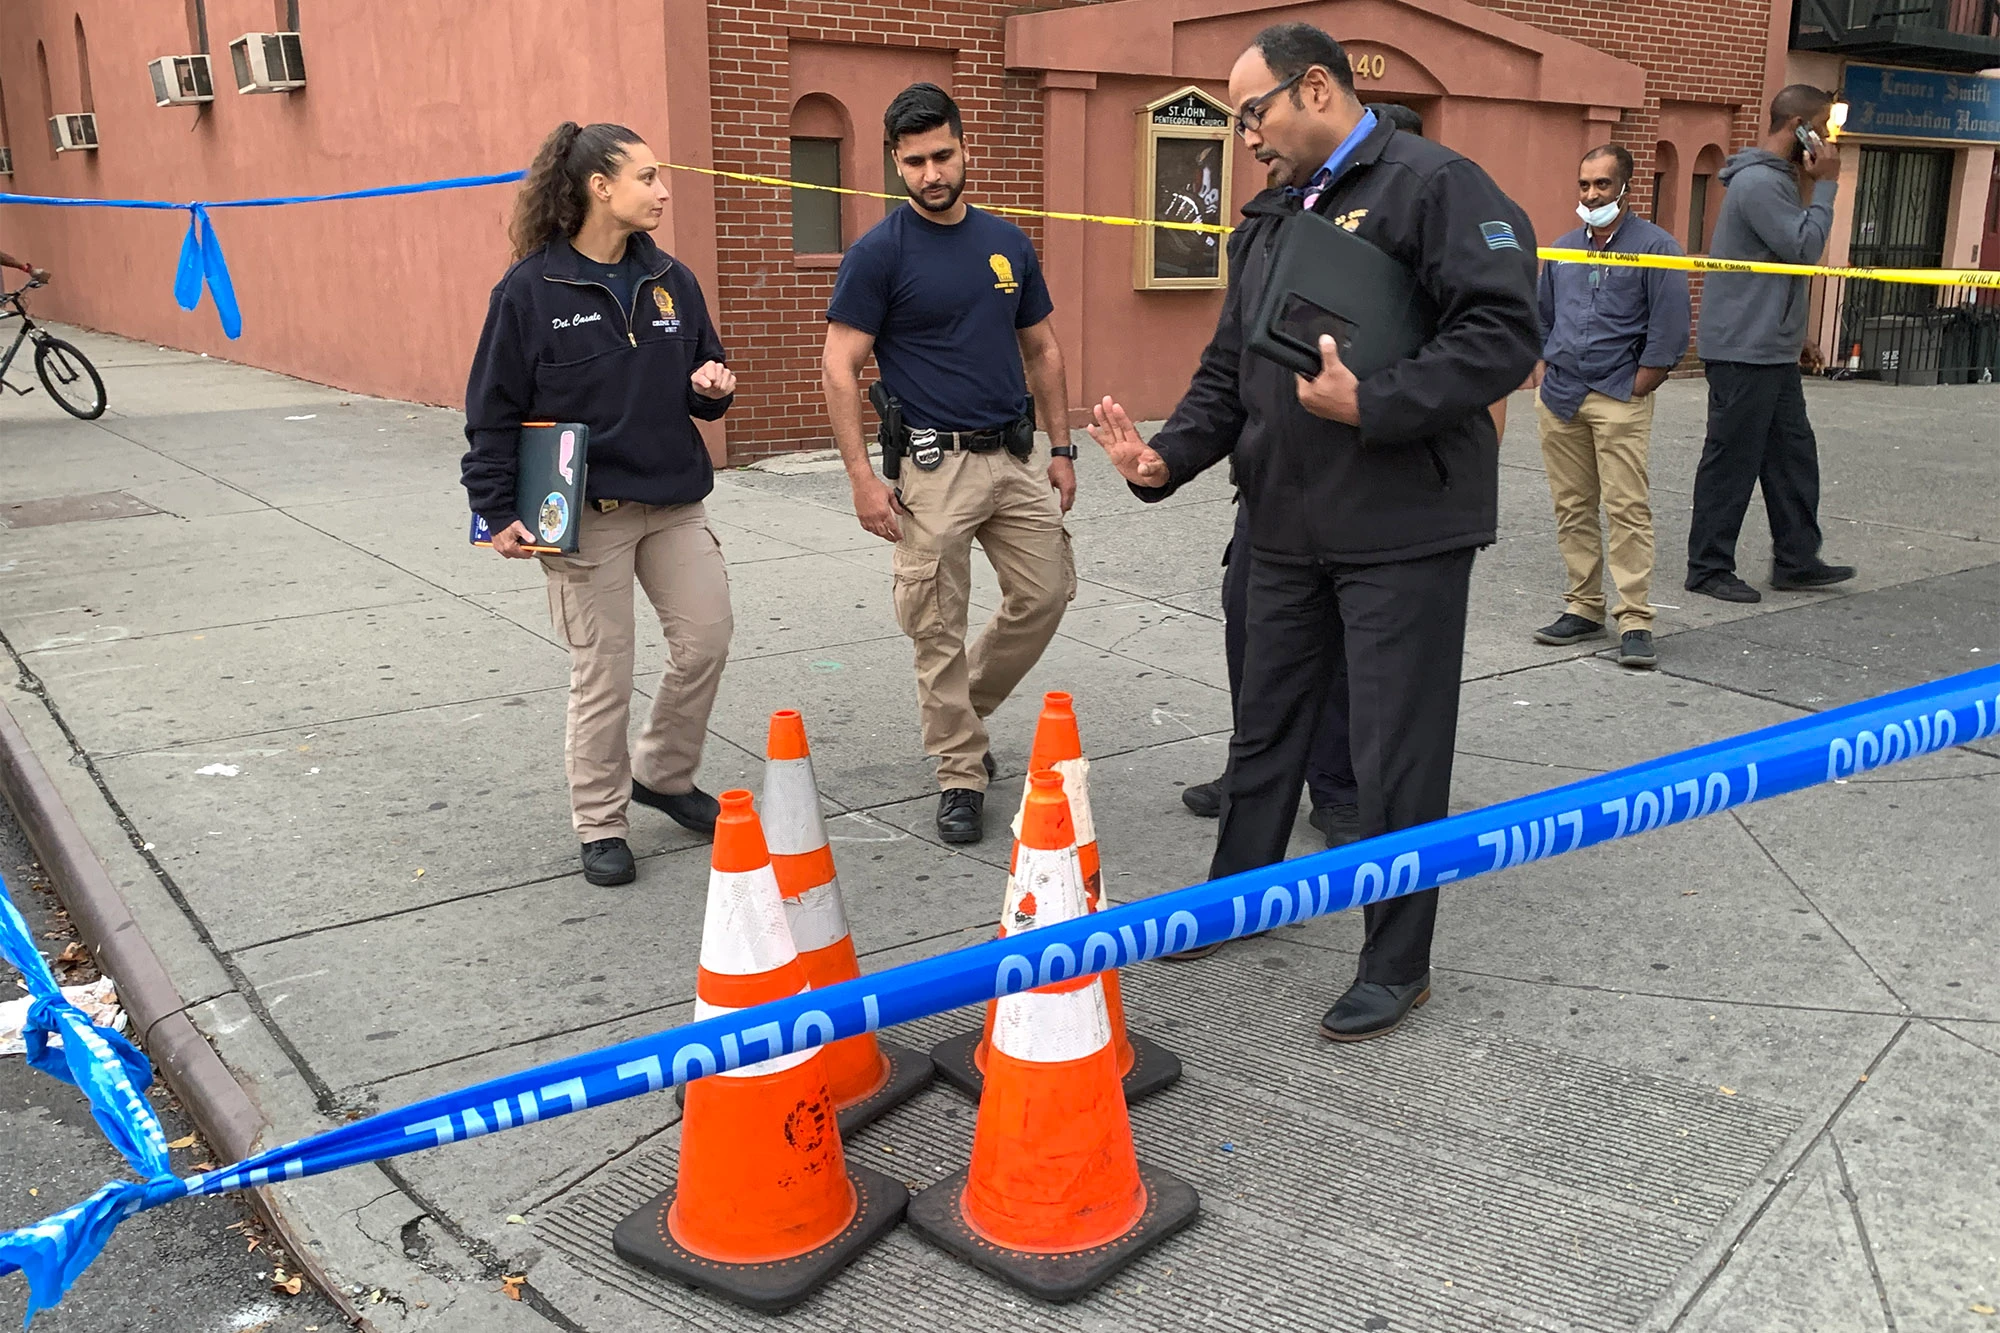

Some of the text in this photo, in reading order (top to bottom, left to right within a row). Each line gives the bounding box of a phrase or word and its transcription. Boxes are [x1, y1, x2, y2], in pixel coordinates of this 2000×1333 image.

[1880, 71, 1991, 108] Lenora Smith
[1181, 107, 1206, 118] JOHN
[1861, 101, 1951, 130] Foundation
[1154, 115, 1225, 127] PENTECOSTAL CHURCH
[551, 317, 571, 330] Det.
